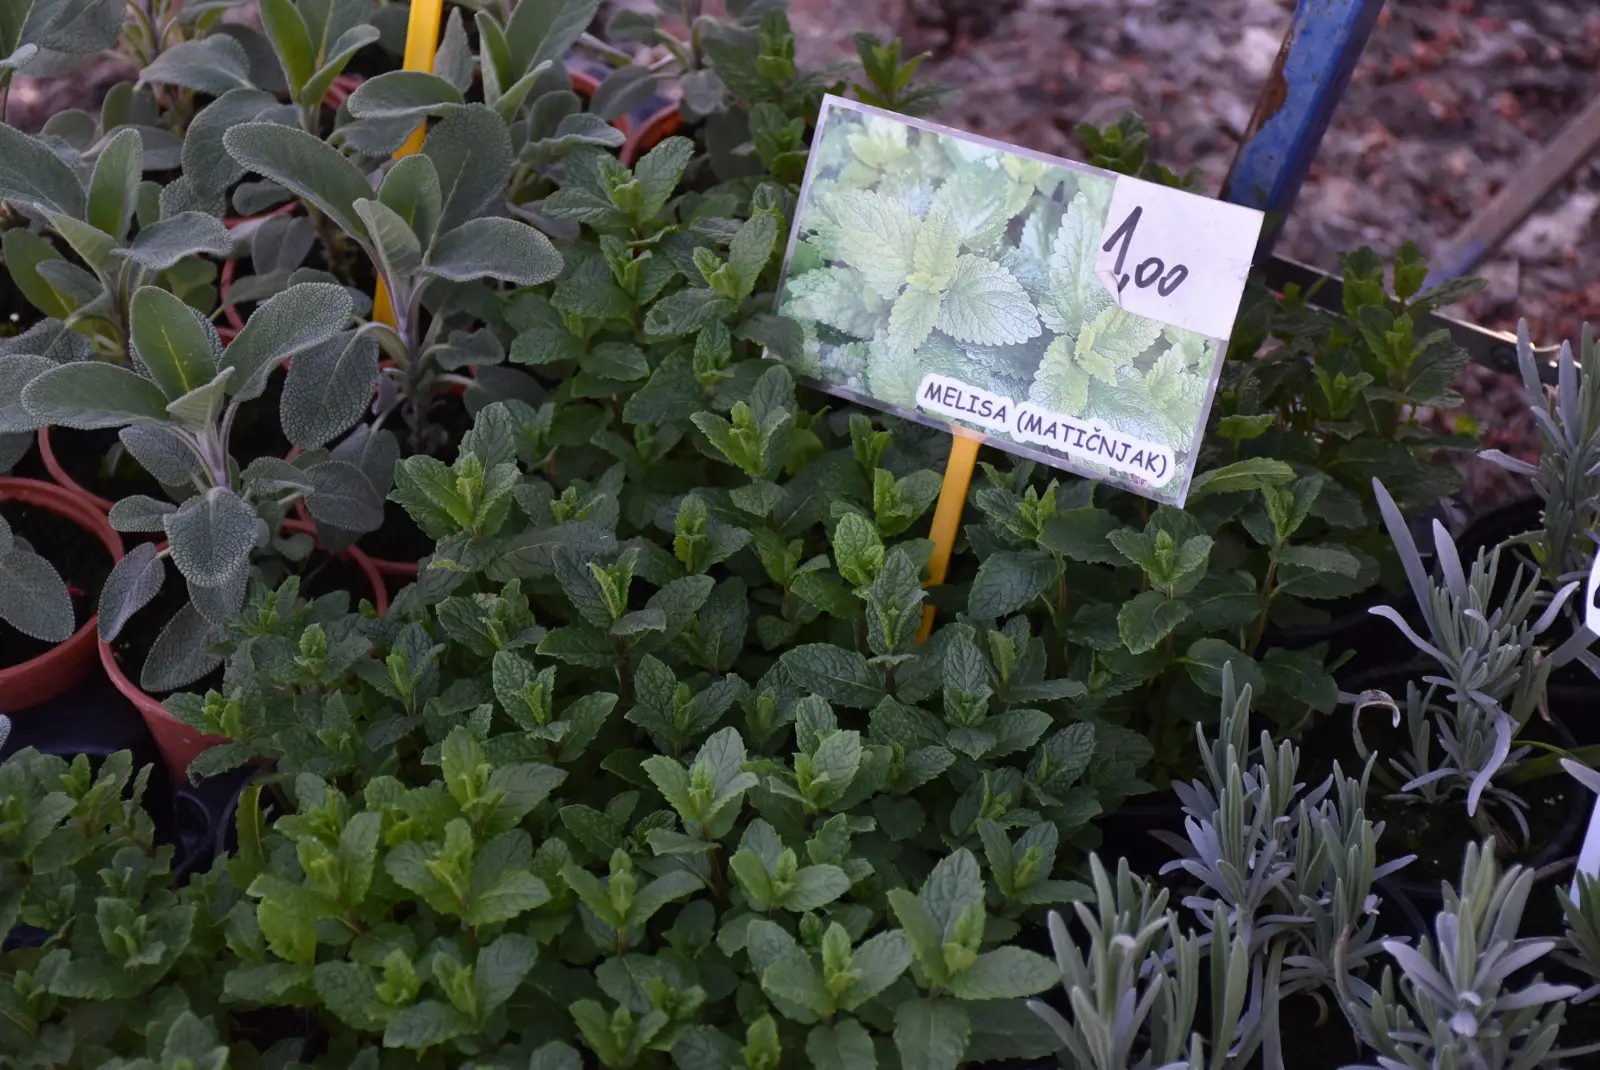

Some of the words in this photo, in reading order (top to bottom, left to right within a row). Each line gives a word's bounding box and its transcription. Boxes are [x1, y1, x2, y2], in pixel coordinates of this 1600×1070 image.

[1103, 206, 1189, 297] 1,00
[924, 382, 1007, 424] MELISA
[1017, 410, 1168, 478] (MATIČNJAK)
